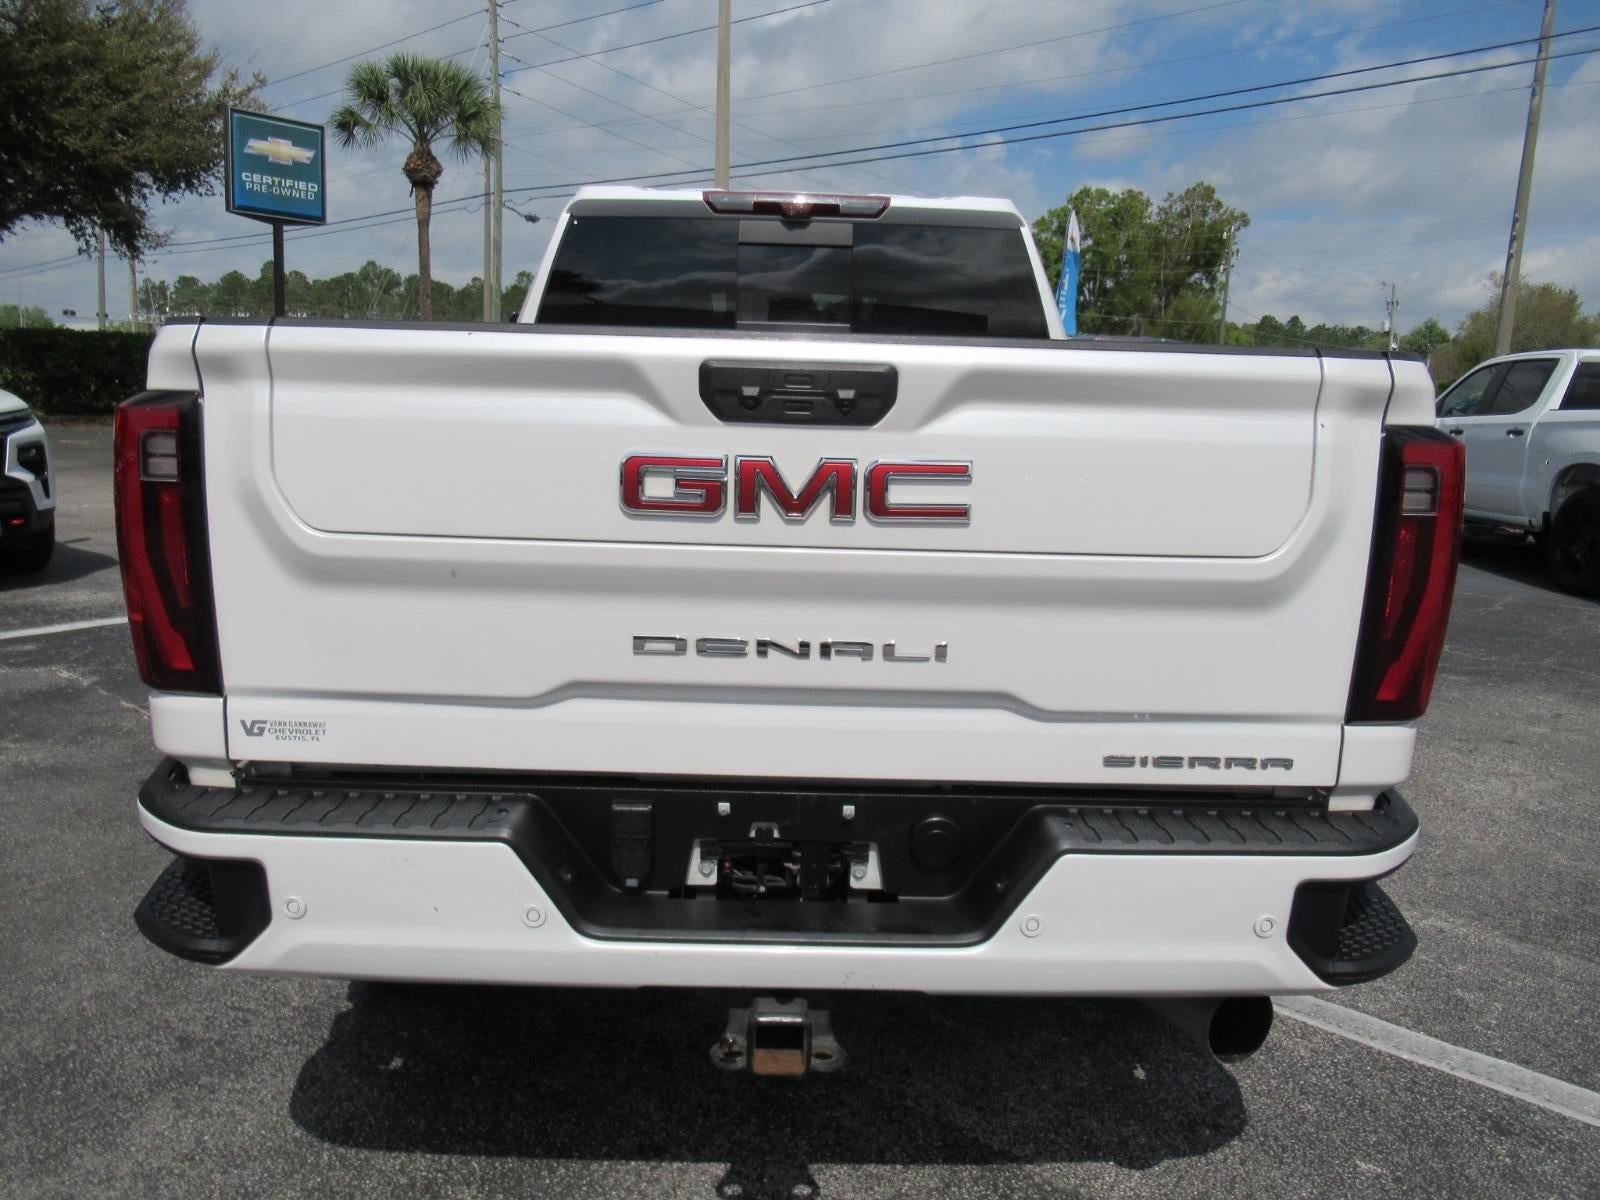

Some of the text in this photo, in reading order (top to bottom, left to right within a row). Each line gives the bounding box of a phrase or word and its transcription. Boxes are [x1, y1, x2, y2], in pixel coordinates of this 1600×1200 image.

[242, 172, 318, 192] CERTIFIED
[246, 182, 315, 200] PRE-OWNED
[619, 453, 973, 525] GMC
[632, 634, 948, 664] DENALI
[1102, 755, 1294, 771] SIERRA
